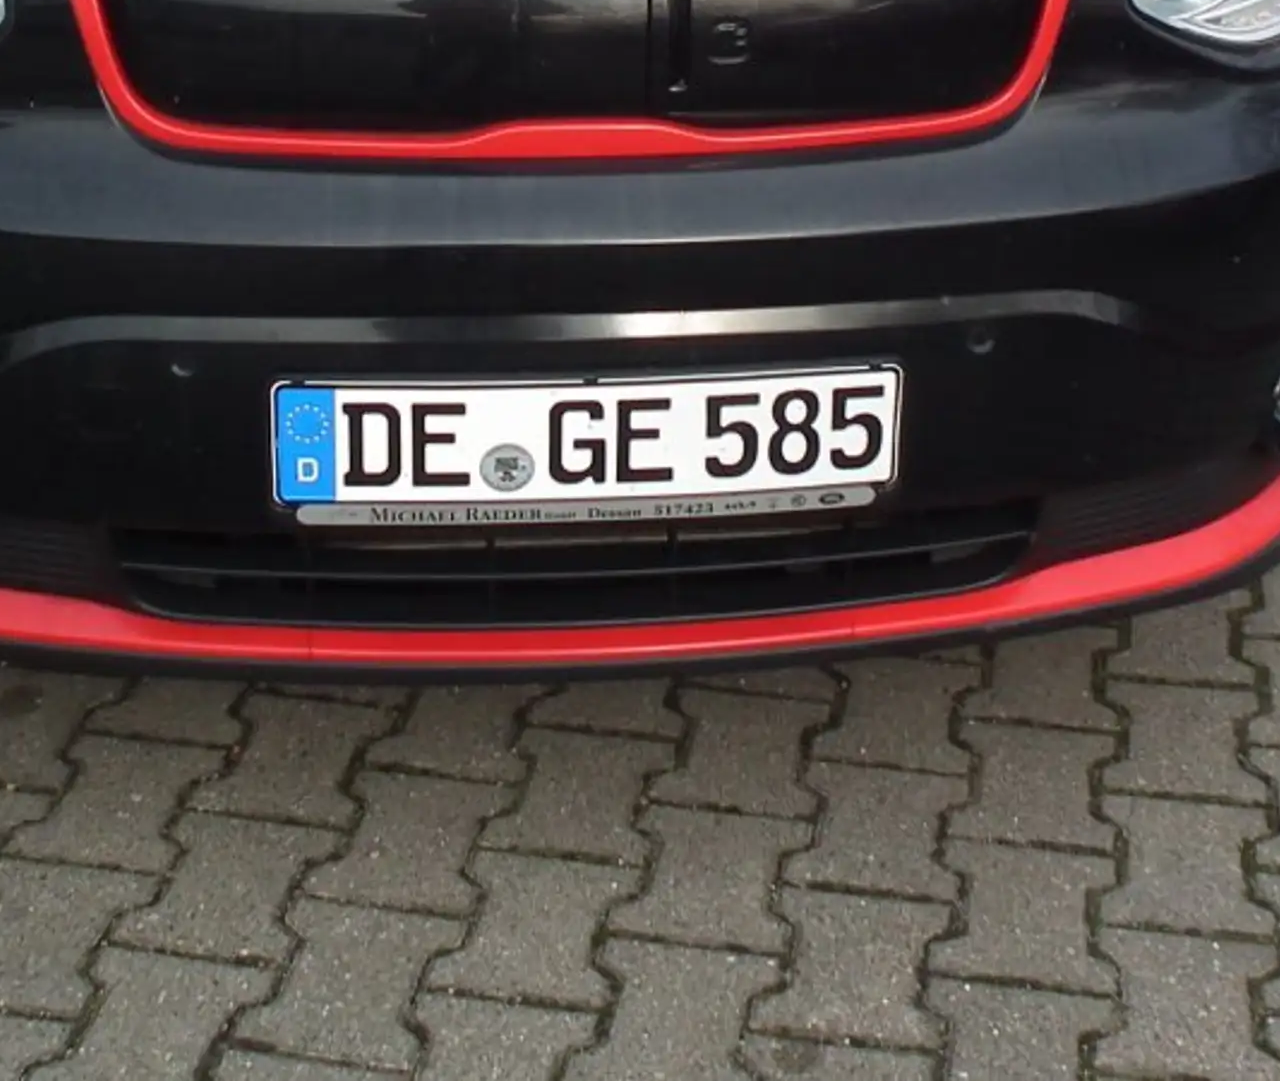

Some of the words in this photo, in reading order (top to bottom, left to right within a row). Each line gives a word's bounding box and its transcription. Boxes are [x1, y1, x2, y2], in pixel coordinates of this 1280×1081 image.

[296, 456, 319, 483] D
[341, 402, 471, 488] DE
[548, 397, 674, 485] GE
[704, 384, 885, 478] 585
[466, 506, 541, 521] RAEDER
